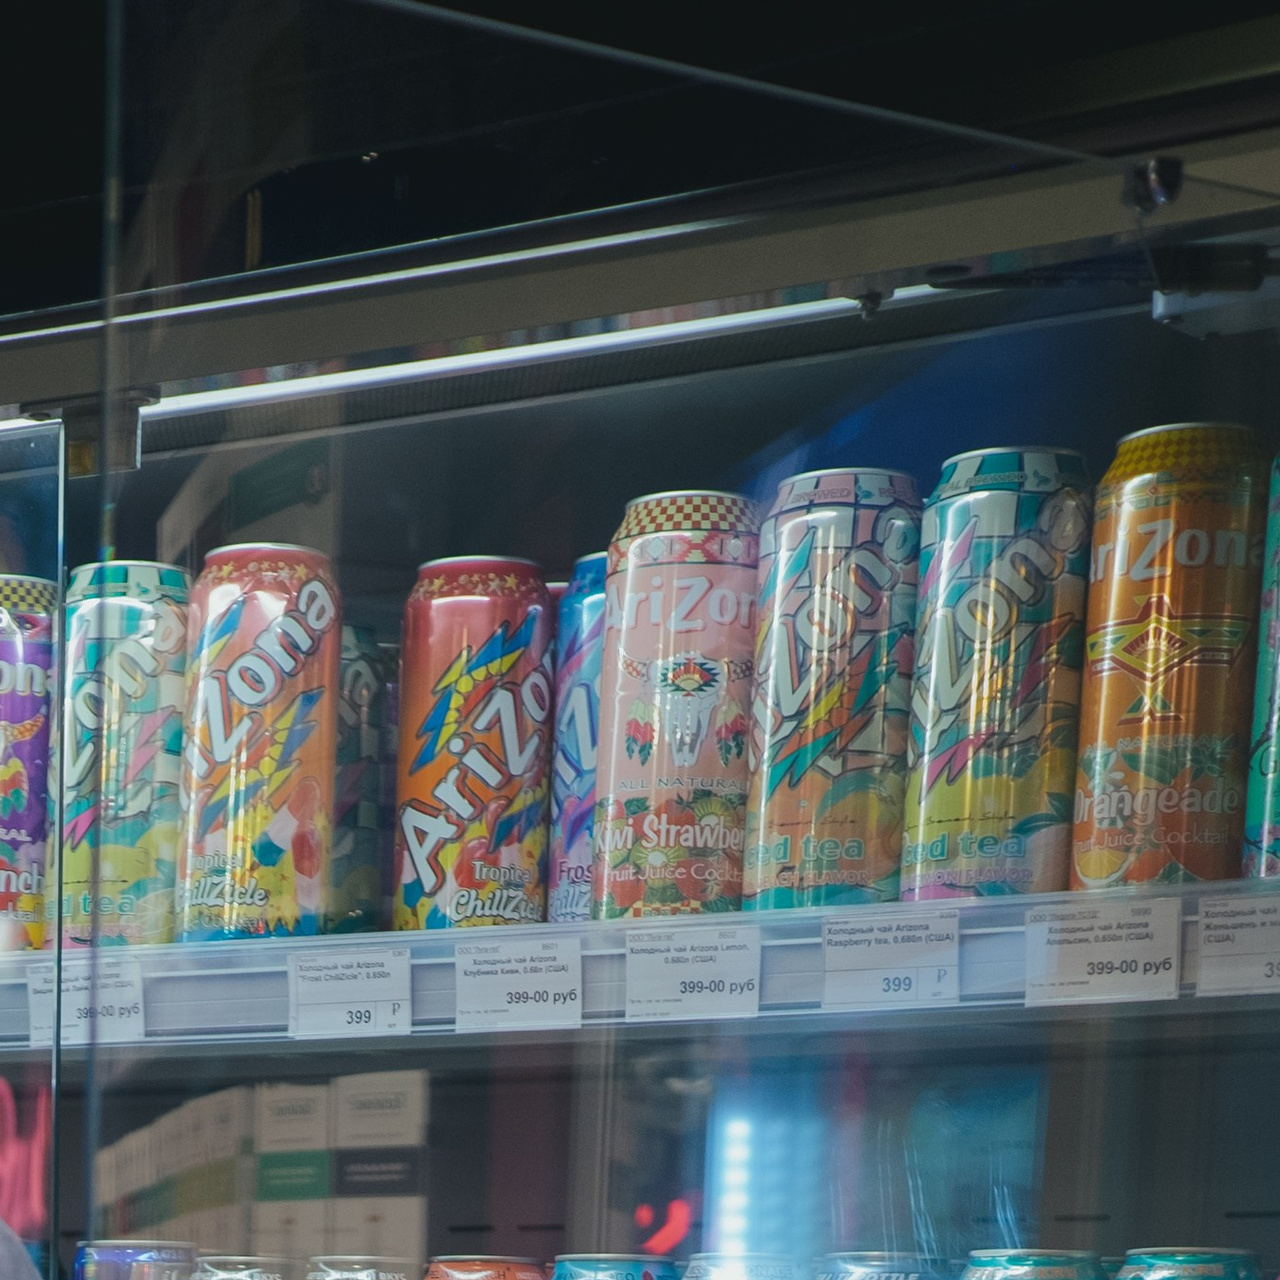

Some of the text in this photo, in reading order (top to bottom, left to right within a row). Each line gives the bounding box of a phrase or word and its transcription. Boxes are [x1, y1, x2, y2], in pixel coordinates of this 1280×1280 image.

[619, 780, 650, 792] ALL
[1074, 776, 1242, 826] Orangeade
[591, 820, 635, 855] Kiwi
[959, 828, 1026, 862] tea
[1150, 825, 1231, 849] Cocktail
[803, 833, 866, 863] tea
[638, 861, 686, 886] Juice
[79, 893, 137, 917] tea
[826, 922, 930, 936] Холодный чай Arizona
[1048, 925, 1088, 935] Холодный
[1115, 922, 1149, 932] Arizona
[826, 933, 955, 950] Raspberry (США)
[1124, 932, 1154, 944] (США)
[629, 945, 671, 955] Холодный
[675, 945, 687, 953] чай
[690, 943, 718, 952] Arizona
[299, 963, 339, 973] Холодный
[356, 960, 385, 970] Arizona
[473, 954, 557, 966] Холодный чай Arizona
[691, 954, 718, 965] (США)
[1086, 957, 1173, 975] 399-00 руб
[545, 965, 569, 975] (США)
[679, 978, 756, 995] 399-00 руб
[881, 977, 913, 994] 399
[506, 988, 578, 1005] 399-00 руб
[119, 1003, 140, 1019] руб
[346, 1010, 372, 1026] 399
